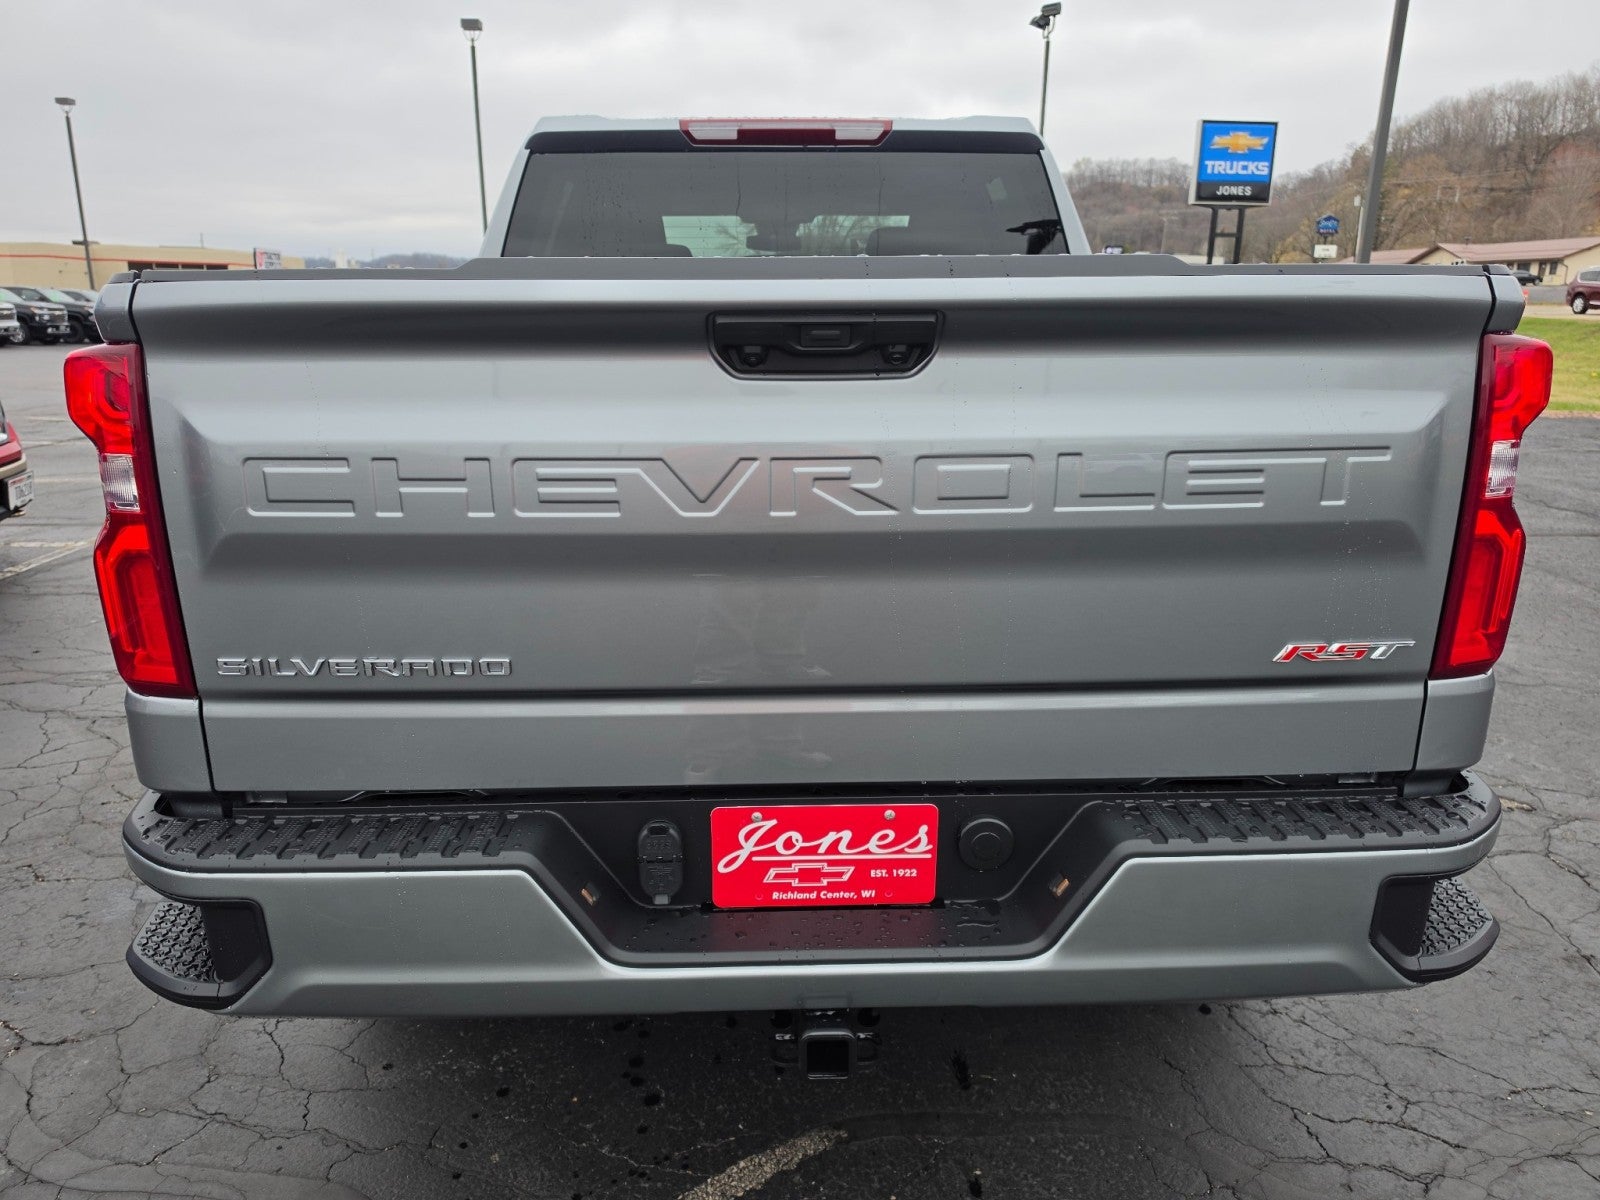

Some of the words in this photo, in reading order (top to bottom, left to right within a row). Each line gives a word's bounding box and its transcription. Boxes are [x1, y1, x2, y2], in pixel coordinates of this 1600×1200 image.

[1204, 160, 1270, 175] TRUCKS
[1215, 185, 1253, 196] JONES
[243, 446, 1392, 518] CHEVROLET
[1272, 640, 1417, 663] RST
[216, 656, 512, 677] SILVERADO
[717, 818, 934, 874] Jones
[870, 869, 889, 878] EST.
[892, 868, 918, 878] 1922
[772, 890, 818, 900] Richland
[820, 890, 858, 900] Center,
[861, 889, 876, 899] WI
